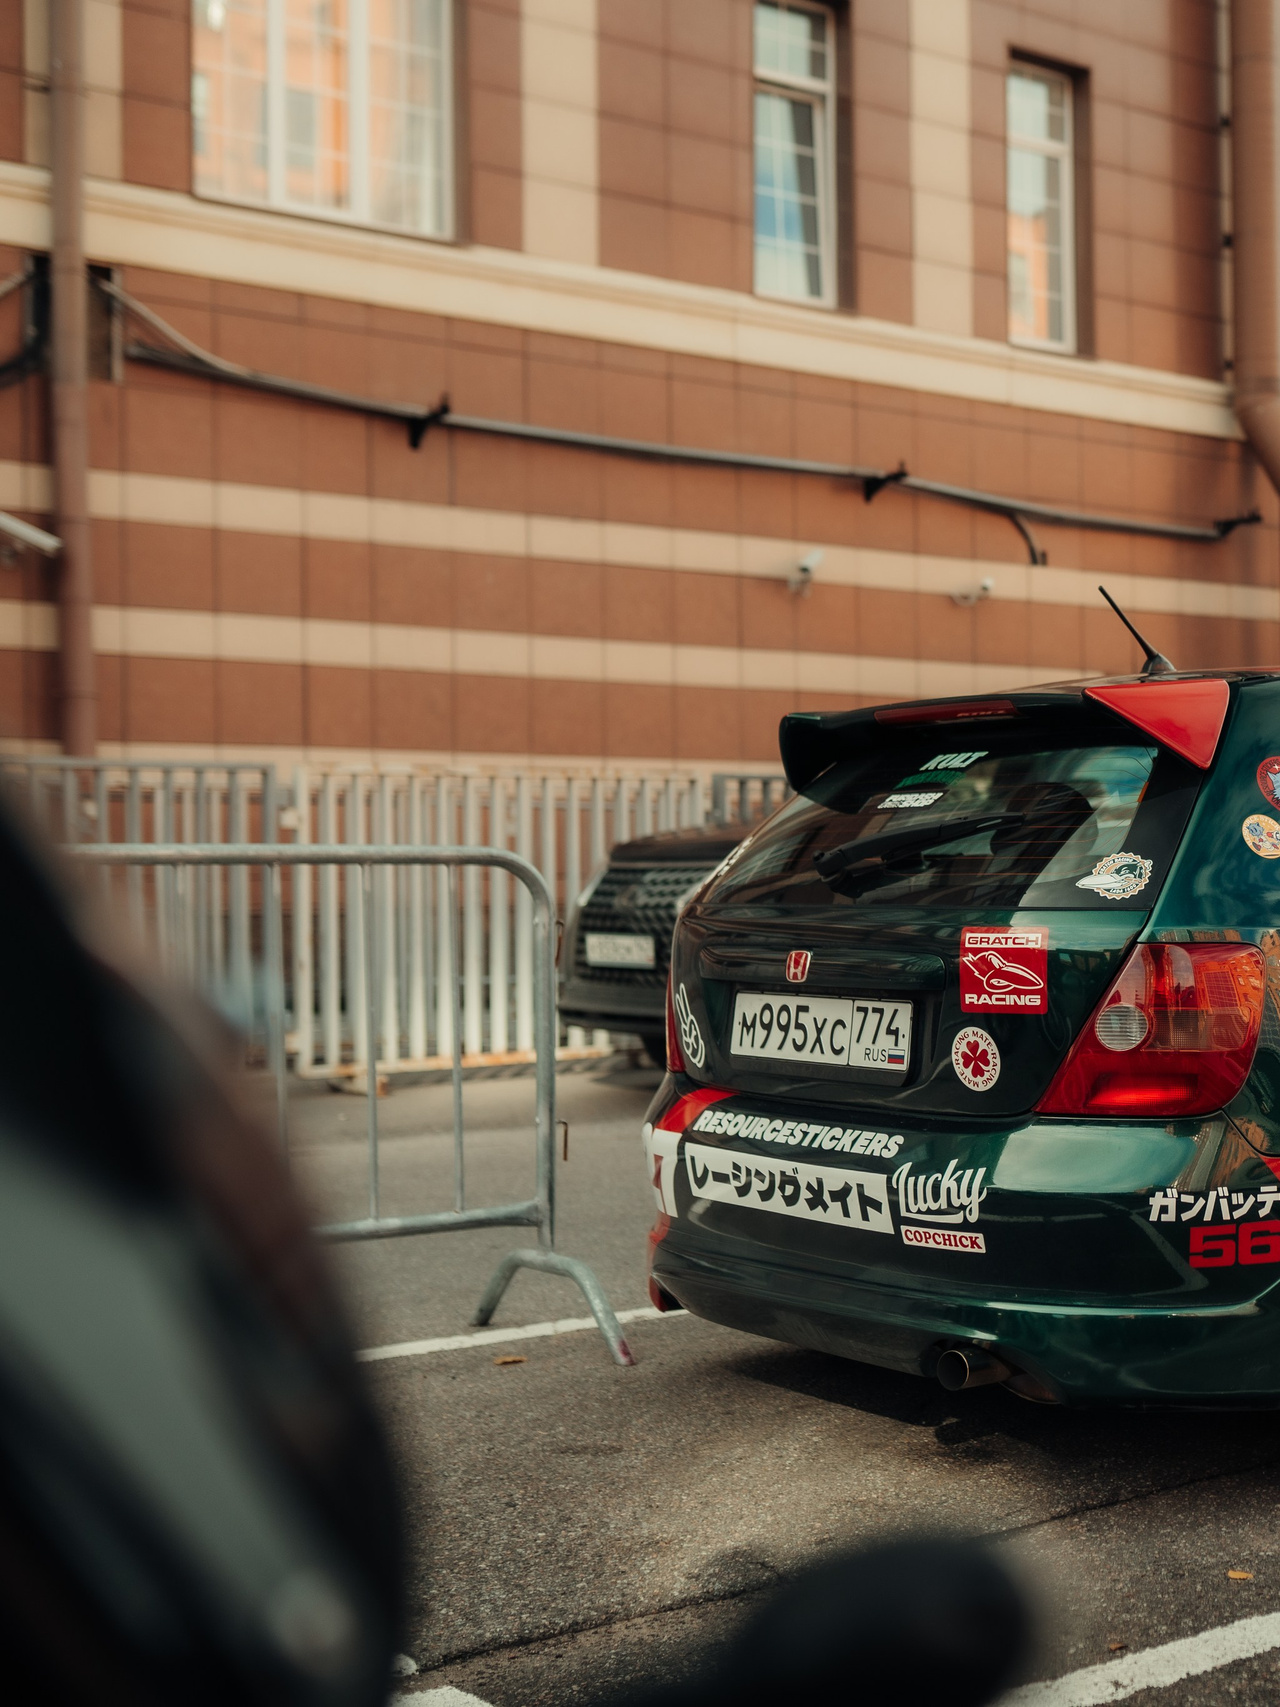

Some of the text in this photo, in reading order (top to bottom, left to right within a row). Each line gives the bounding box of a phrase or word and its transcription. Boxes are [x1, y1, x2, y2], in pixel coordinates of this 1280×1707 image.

[920, 751, 988, 771] KULT
[967, 936, 1040, 946] GRATCH
[965, 994, 1041, 1006] RACING
[855, 1006, 900, 1047] 774
[864, 1048, 886, 1063] RUS
[954, 1030, 993, 1066] RACING MATE
[982, 1051, 998, 1087] RACING
[693, 1110, 905, 1159] RESOURCESTICKERS
[689, 1154, 884, 1222] レーシングメイト
[892, 1159, 987, 1223] Lucky
[904, 1229, 983, 1250] COPCHICK
